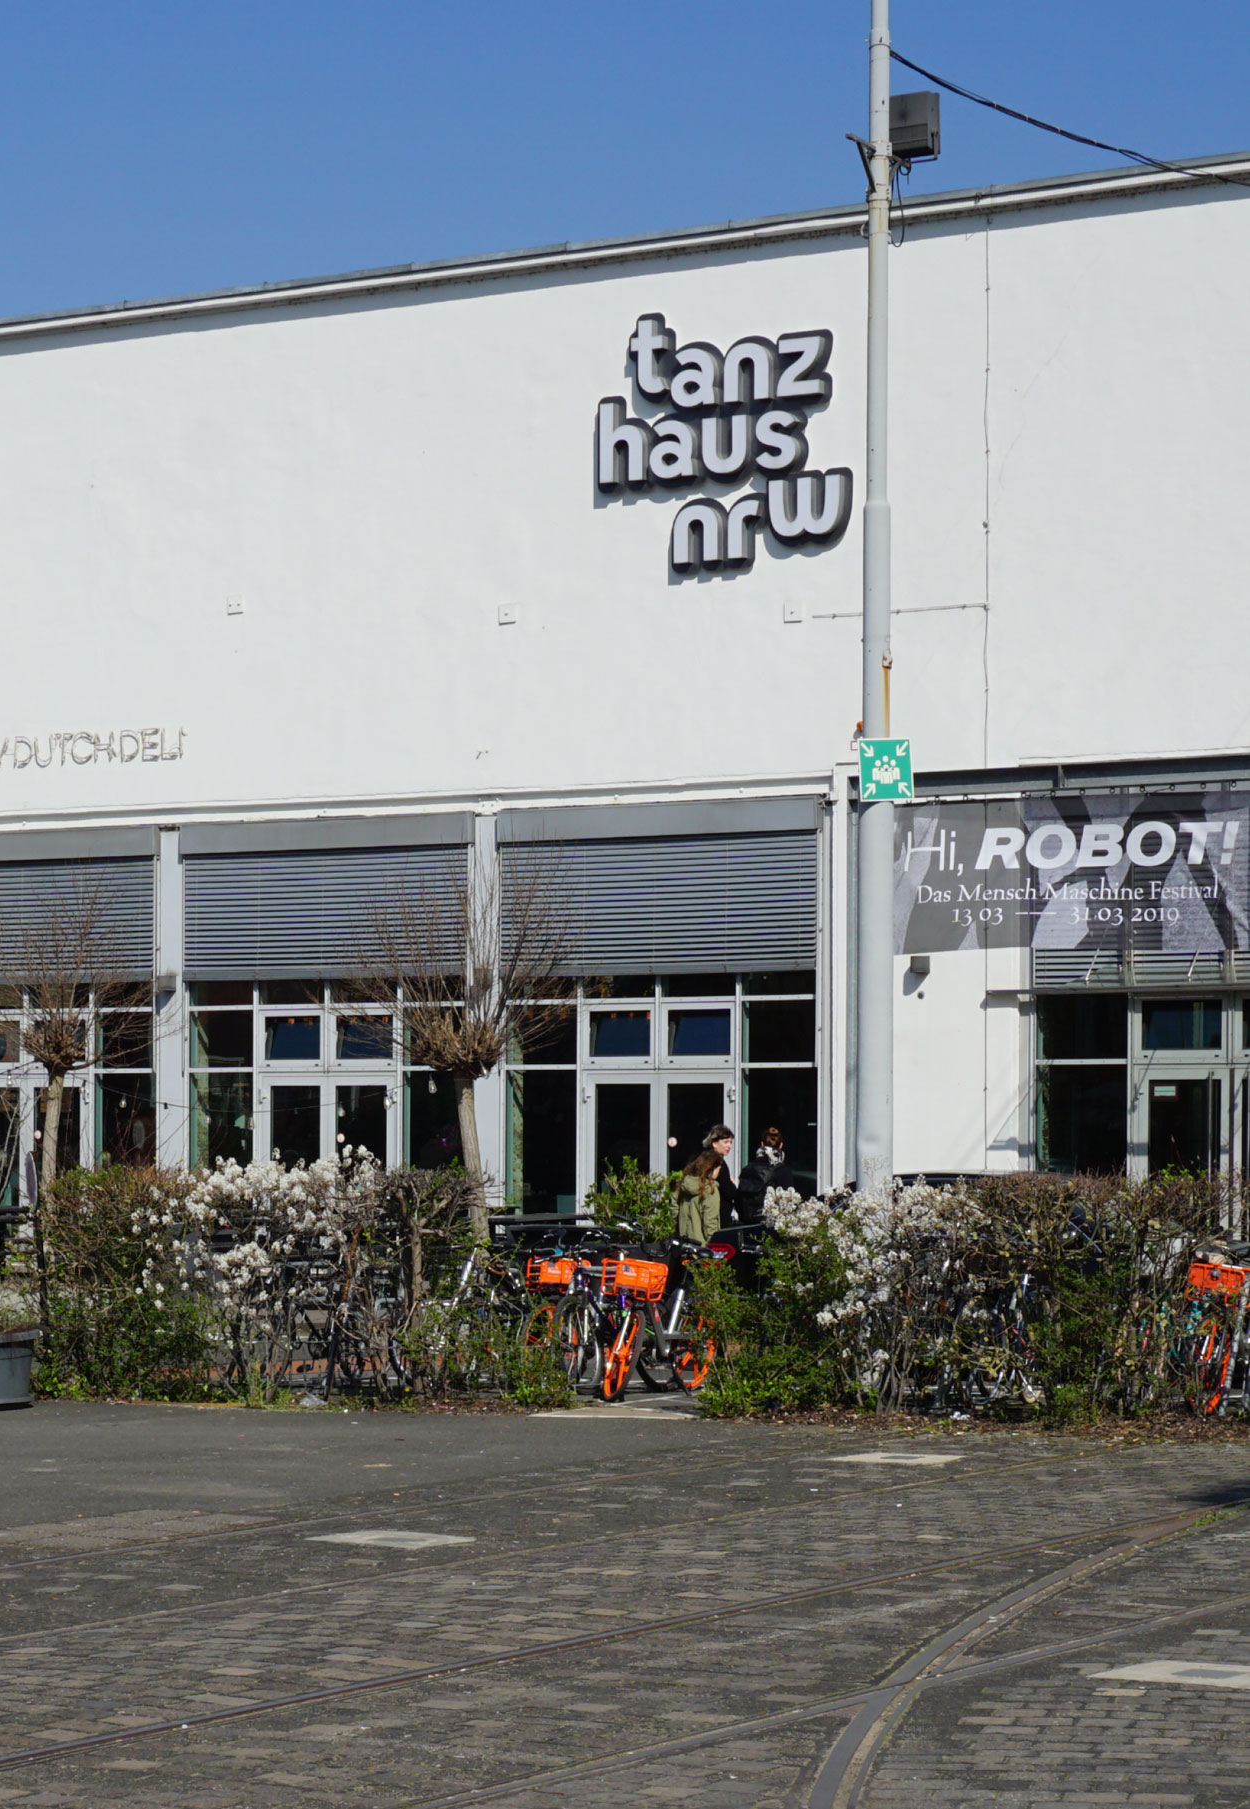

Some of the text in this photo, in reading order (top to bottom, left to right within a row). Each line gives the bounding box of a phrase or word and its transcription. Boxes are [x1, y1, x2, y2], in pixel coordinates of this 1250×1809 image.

[629, 312, 833, 412] tanz
[597, 396, 808, 492] haus
[671, 468, 853, 572] nrw
[904, 821, 1240, 877] Hi, ROBOT!
[917, 874, 1218, 904] Das Mensch Maschine Festival
[1131, 907, 1179, 926] 2019
